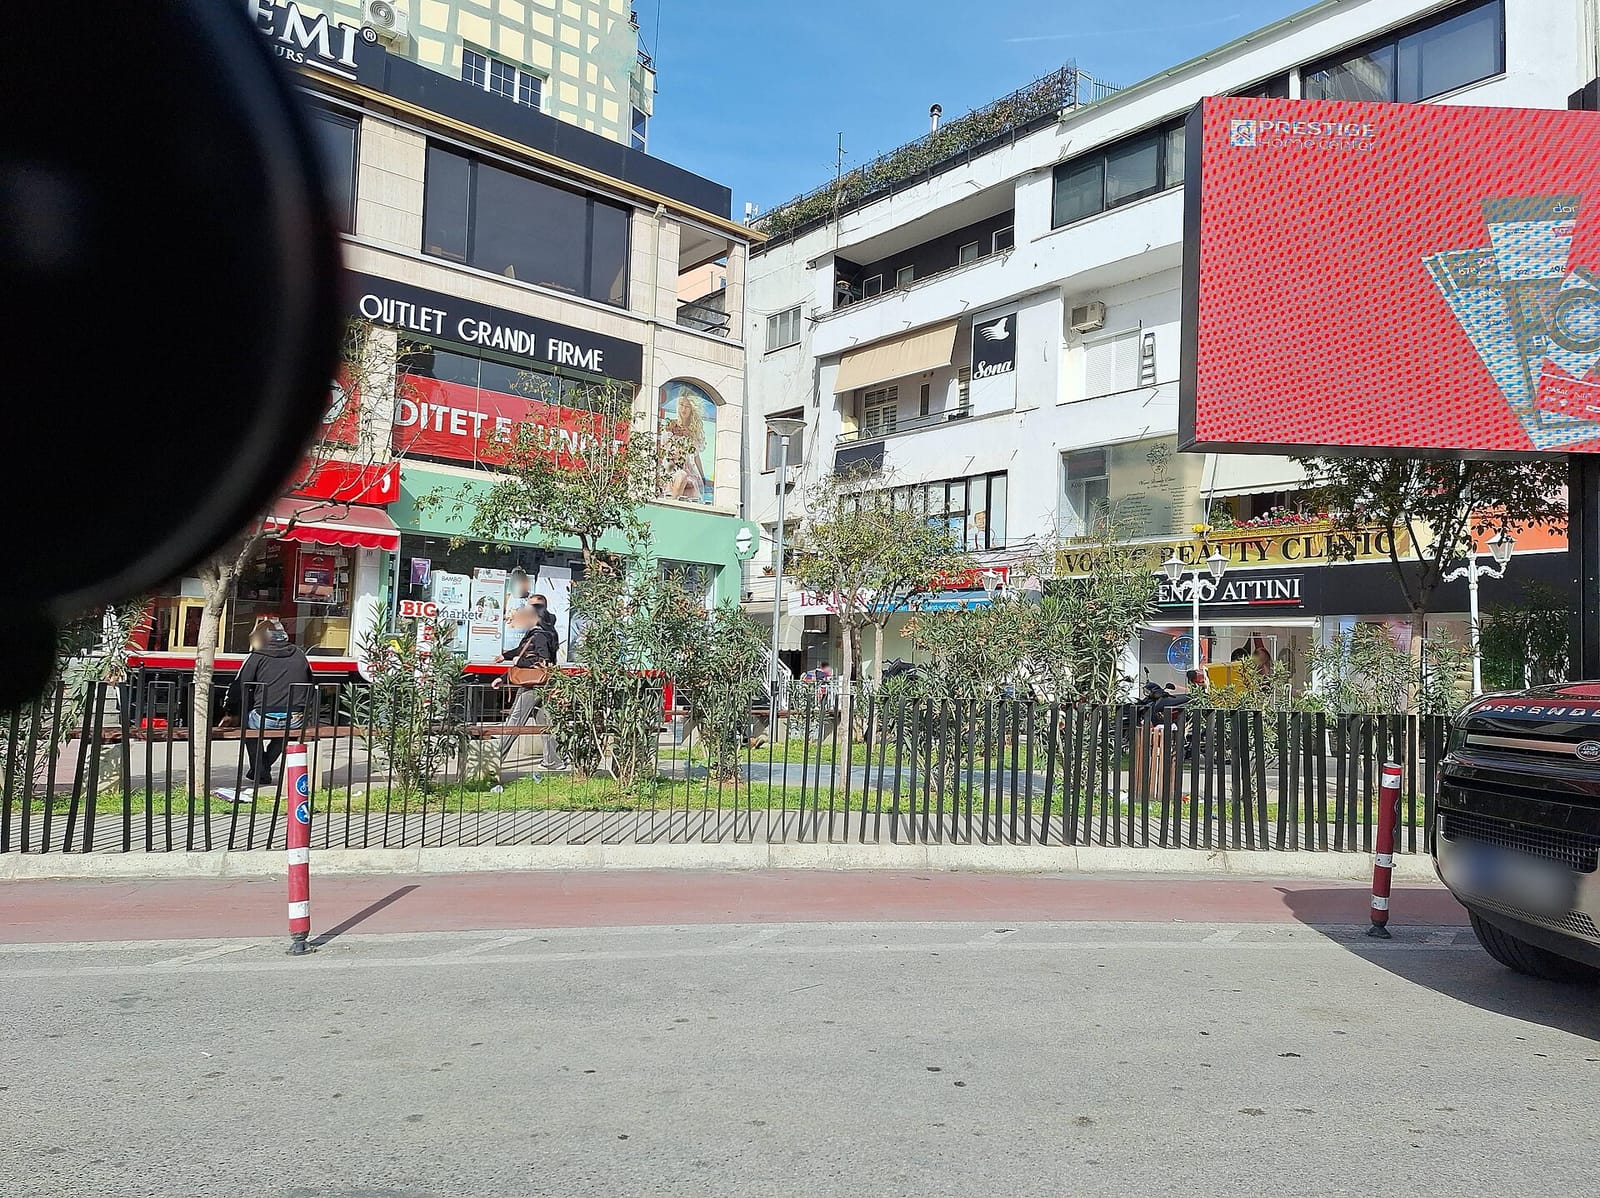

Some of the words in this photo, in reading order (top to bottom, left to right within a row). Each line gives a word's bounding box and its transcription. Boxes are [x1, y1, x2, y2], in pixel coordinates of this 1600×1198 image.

[247, 0, 360, 68] EMI
[273, 44, 304, 64] URS
[1259, 120, 1376, 137] PRESTIGE
[359, 294, 447, 335] OUTLET
[457, 318, 536, 357] GRANDI
[547, 337, 604, 373] FIRME
[974, 360, 1013, 380] Sona
[394, 398, 489, 440] DITET
[494, 416, 512, 443] E
[519, 421, 625, 458] FUNDT
[1160, 537, 1273, 568] BEAUTY
[1282, 530, 1392, 561] CLINIC
[1220, 579, 1300, 600] ATTINI
[402, 601, 437, 617] BIG
